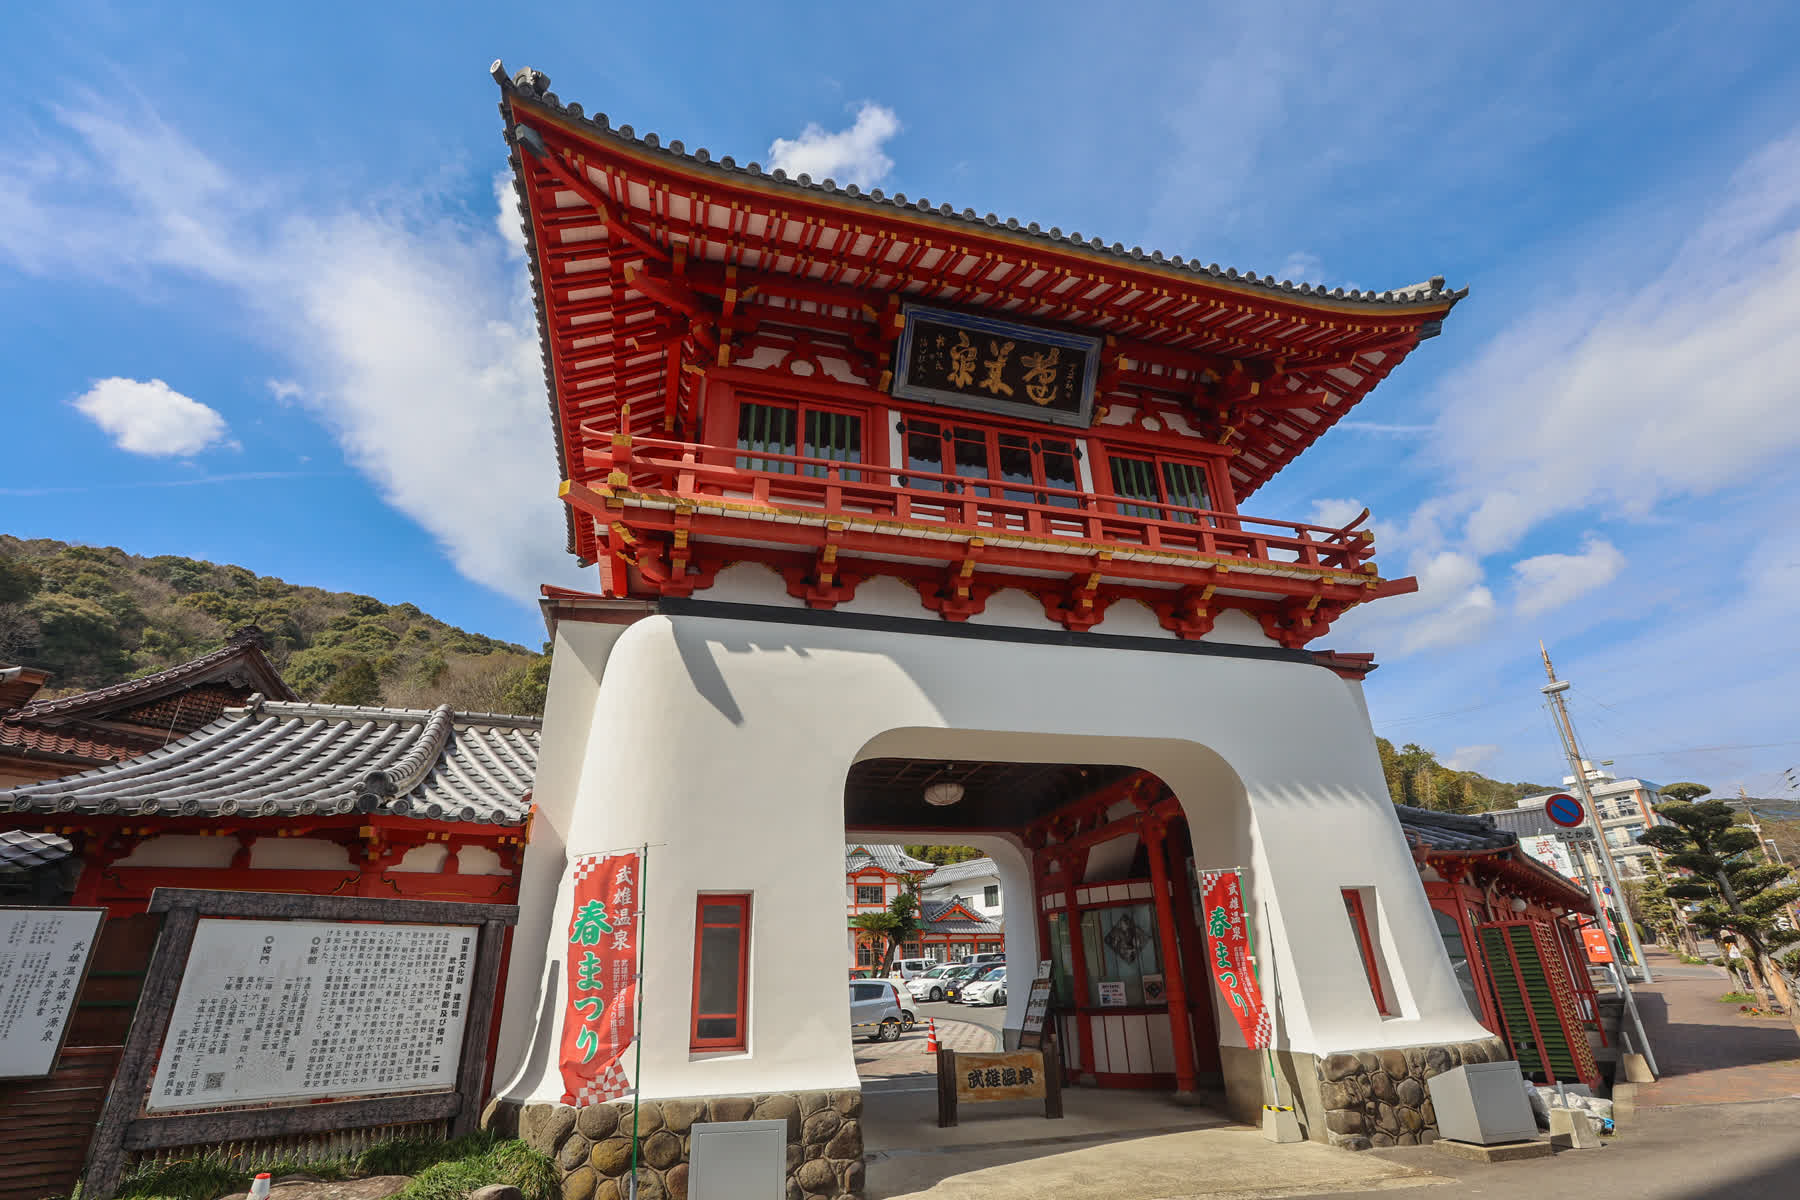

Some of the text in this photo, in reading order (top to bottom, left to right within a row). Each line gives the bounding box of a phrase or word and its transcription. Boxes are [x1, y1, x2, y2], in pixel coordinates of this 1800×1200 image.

[1556, 830, 1592, 841] ここから
[610, 865, 634, 950] 武雄温泉
[1227, 882, 1245, 941] 武雄温泉
[258, 946, 273, 964] 楼門
[306, 946, 319, 964] 新館
[455, 937, 470, 984] 国重要文化財
[1209, 906, 1249, 1018] 春まつり
[40, 941, 85, 1042] 武雄温泉第六源泉
[569, 900, 613, 1064] 春まつり
[967, 1065, 1035, 1089] 武雄温泉
